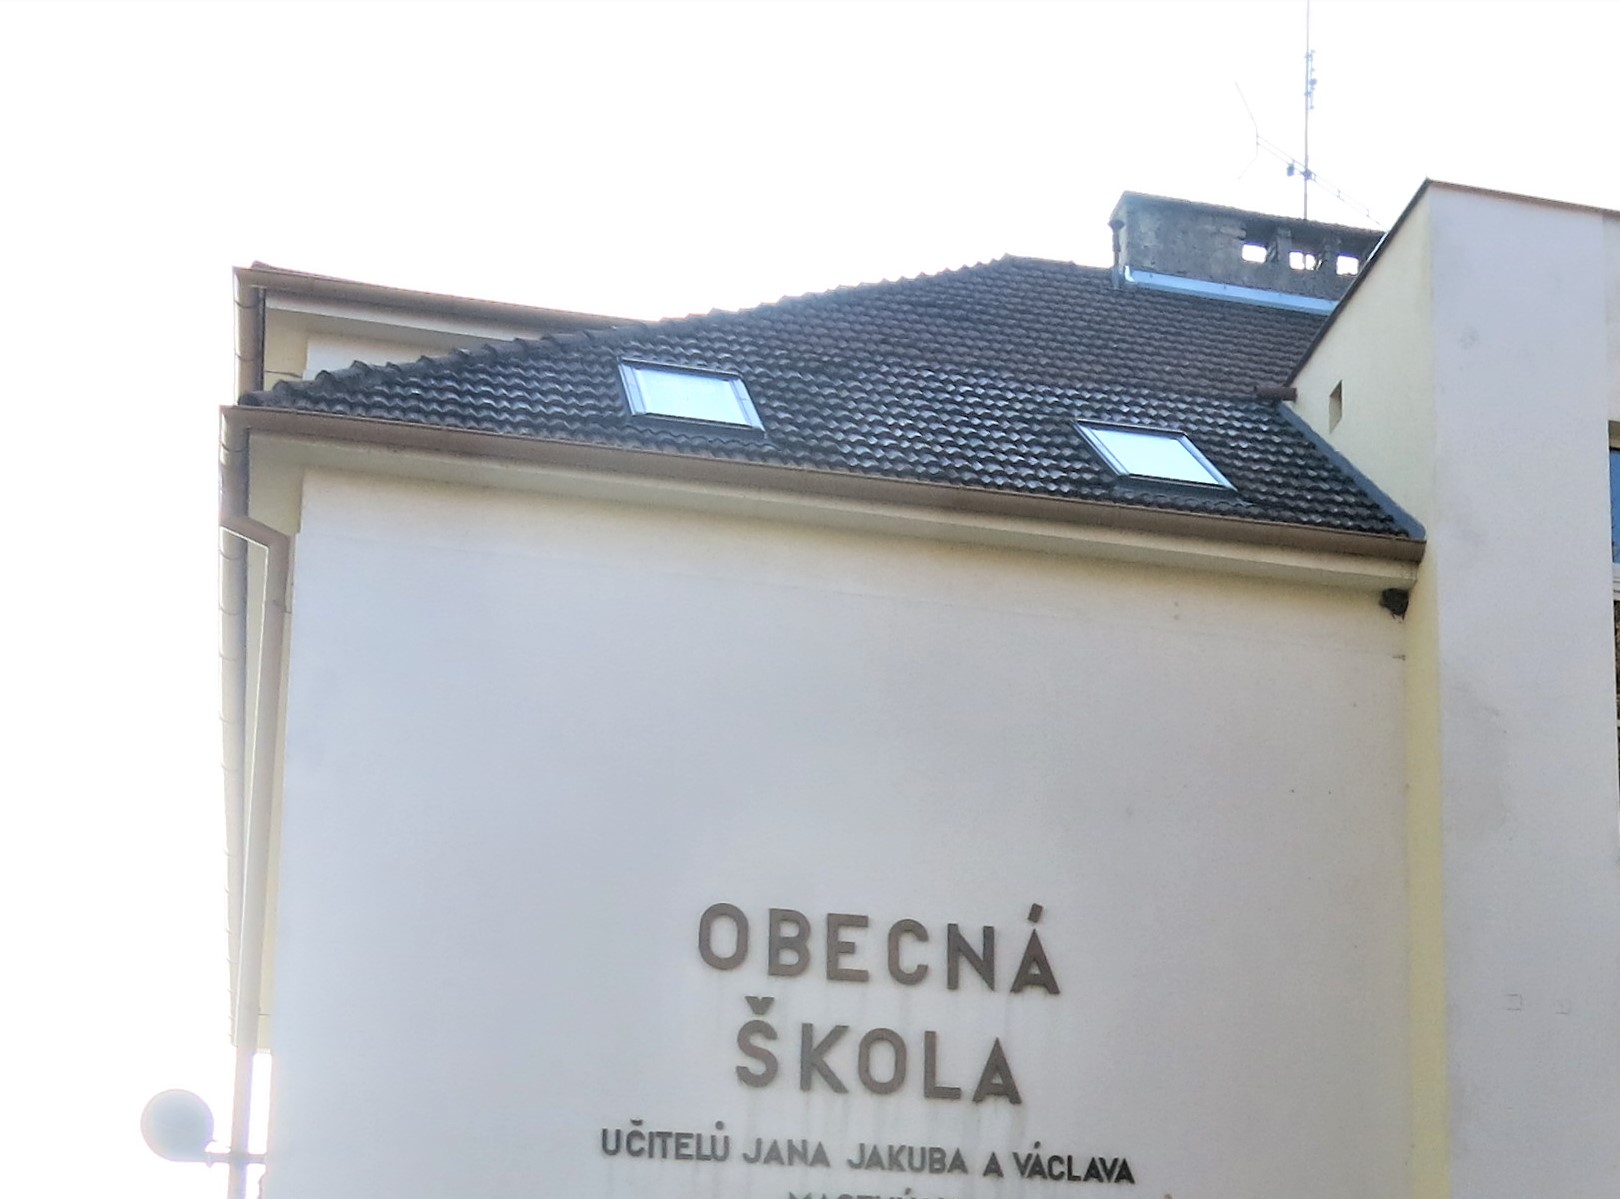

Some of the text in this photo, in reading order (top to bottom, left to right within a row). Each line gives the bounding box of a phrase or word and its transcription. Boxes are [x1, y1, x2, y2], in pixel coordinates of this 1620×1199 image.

[699, 902, 1060, 995] OBECNÁ
[736, 995, 1022, 1105] ŠKOLA
[601, 1118, 1135, 1184] UČITELŮ JANA JAKUBA A VÁCLAVA
